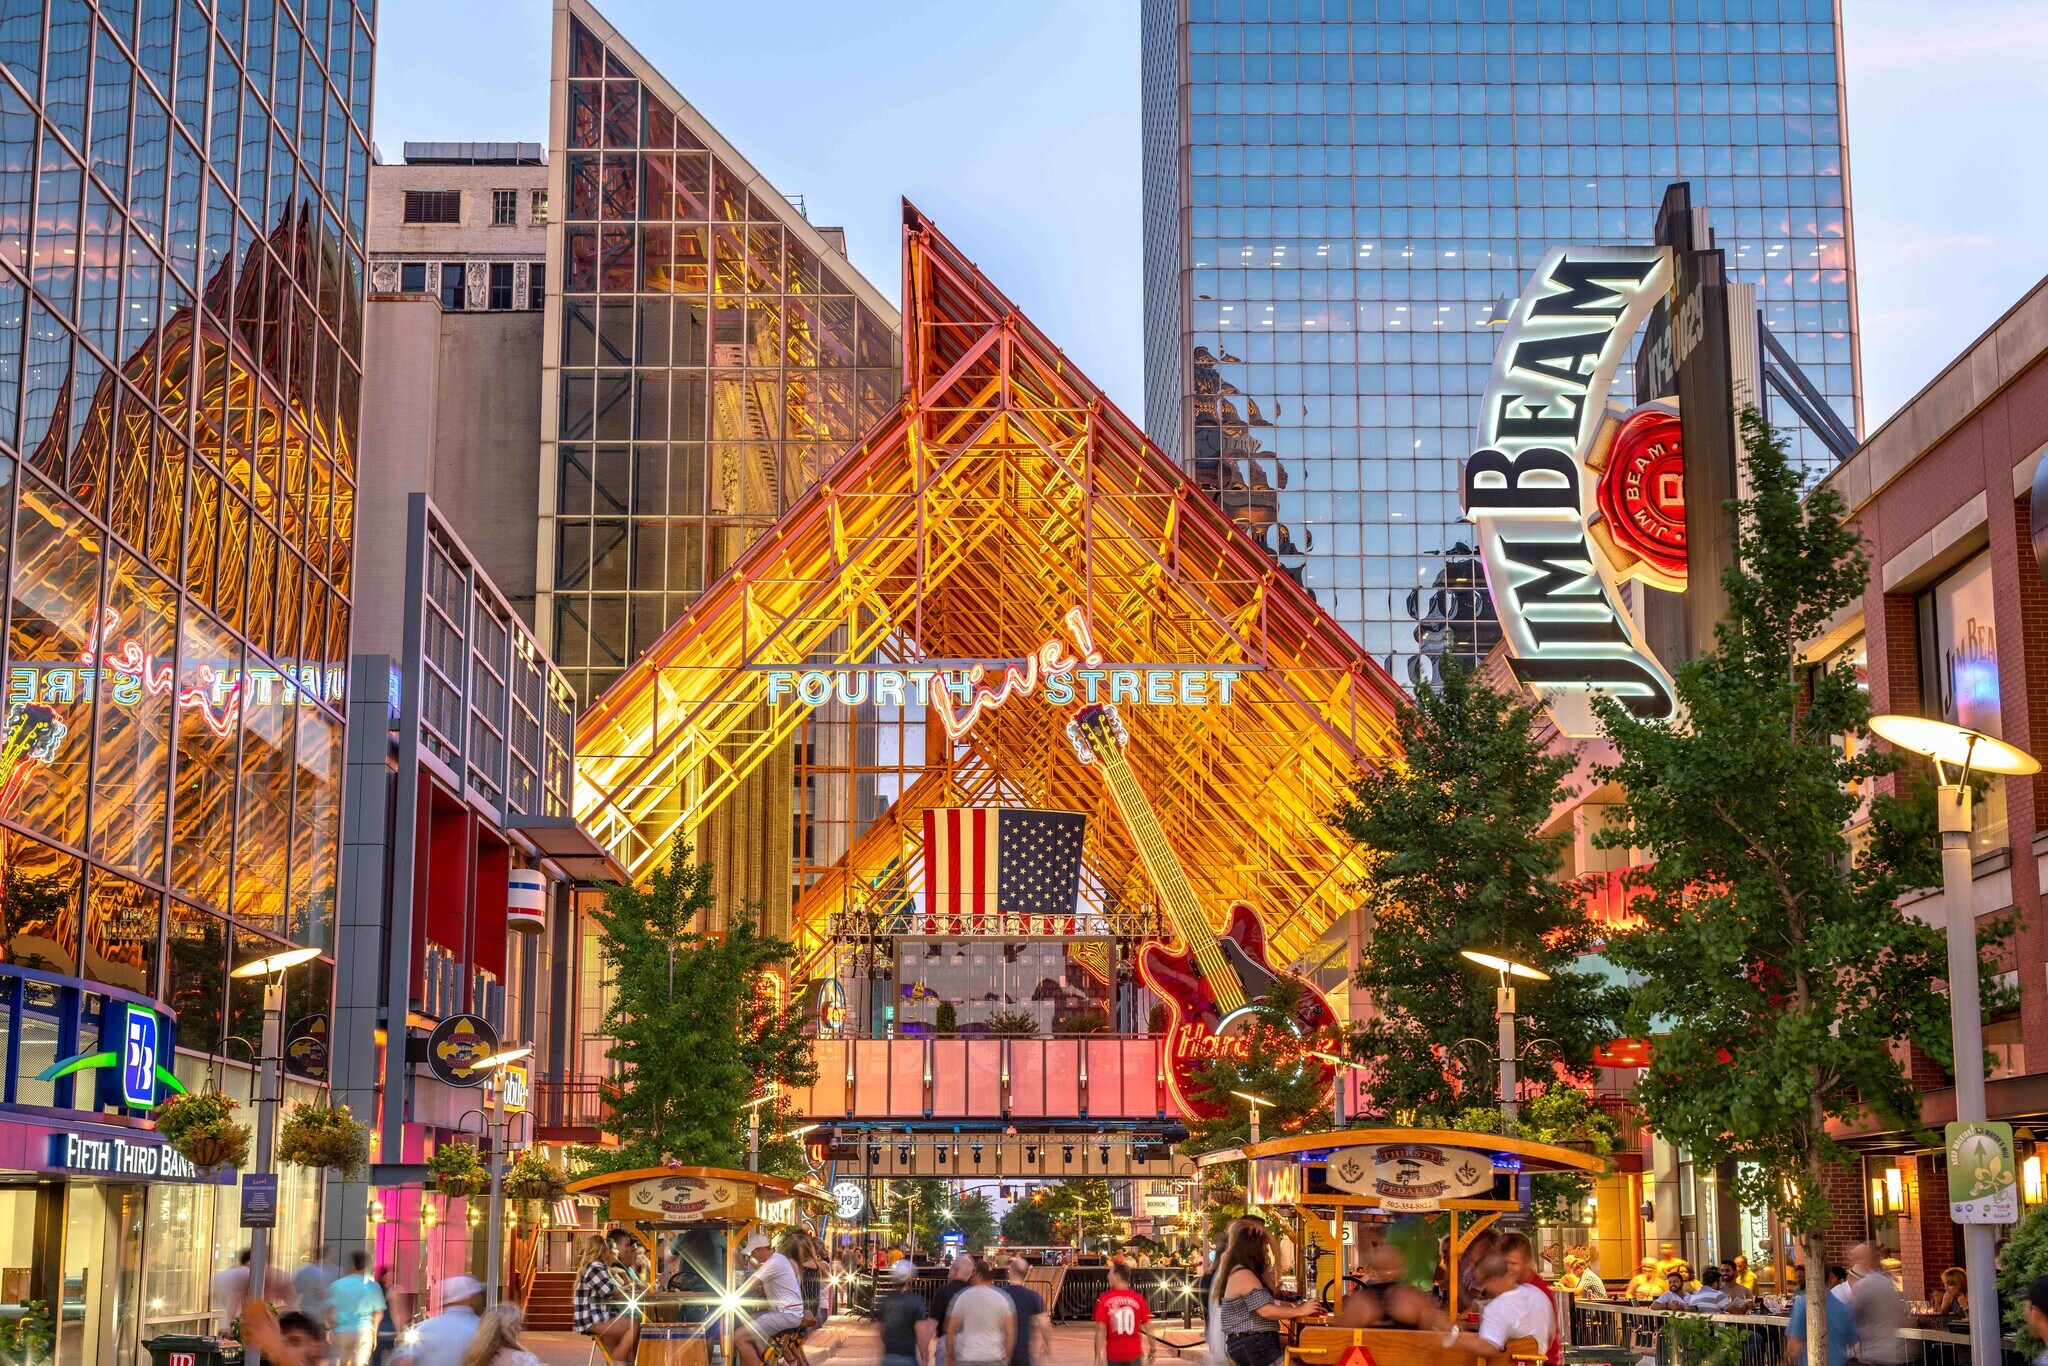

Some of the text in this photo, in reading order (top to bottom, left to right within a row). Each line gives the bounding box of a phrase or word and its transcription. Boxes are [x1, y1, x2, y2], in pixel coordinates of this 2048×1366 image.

[1465, 254, 1674, 720] JIM BEAM
[1626, 443, 1668, 538] JIM BEAM
[767, 669, 1241, 706] FOURTH STREET
[930, 604, 1103, 740] Live!
[1177, 1022, 1254, 1058] Hard
[67, 1133, 110, 1171] FIFTH
[114, 1139, 157, 1175] THIRD
[1380, 1150, 1441, 1162] THIRSTY
[1380, 1184, 1440, 1196] PEDALER
[1114, 1306, 1136, 1336] 10
